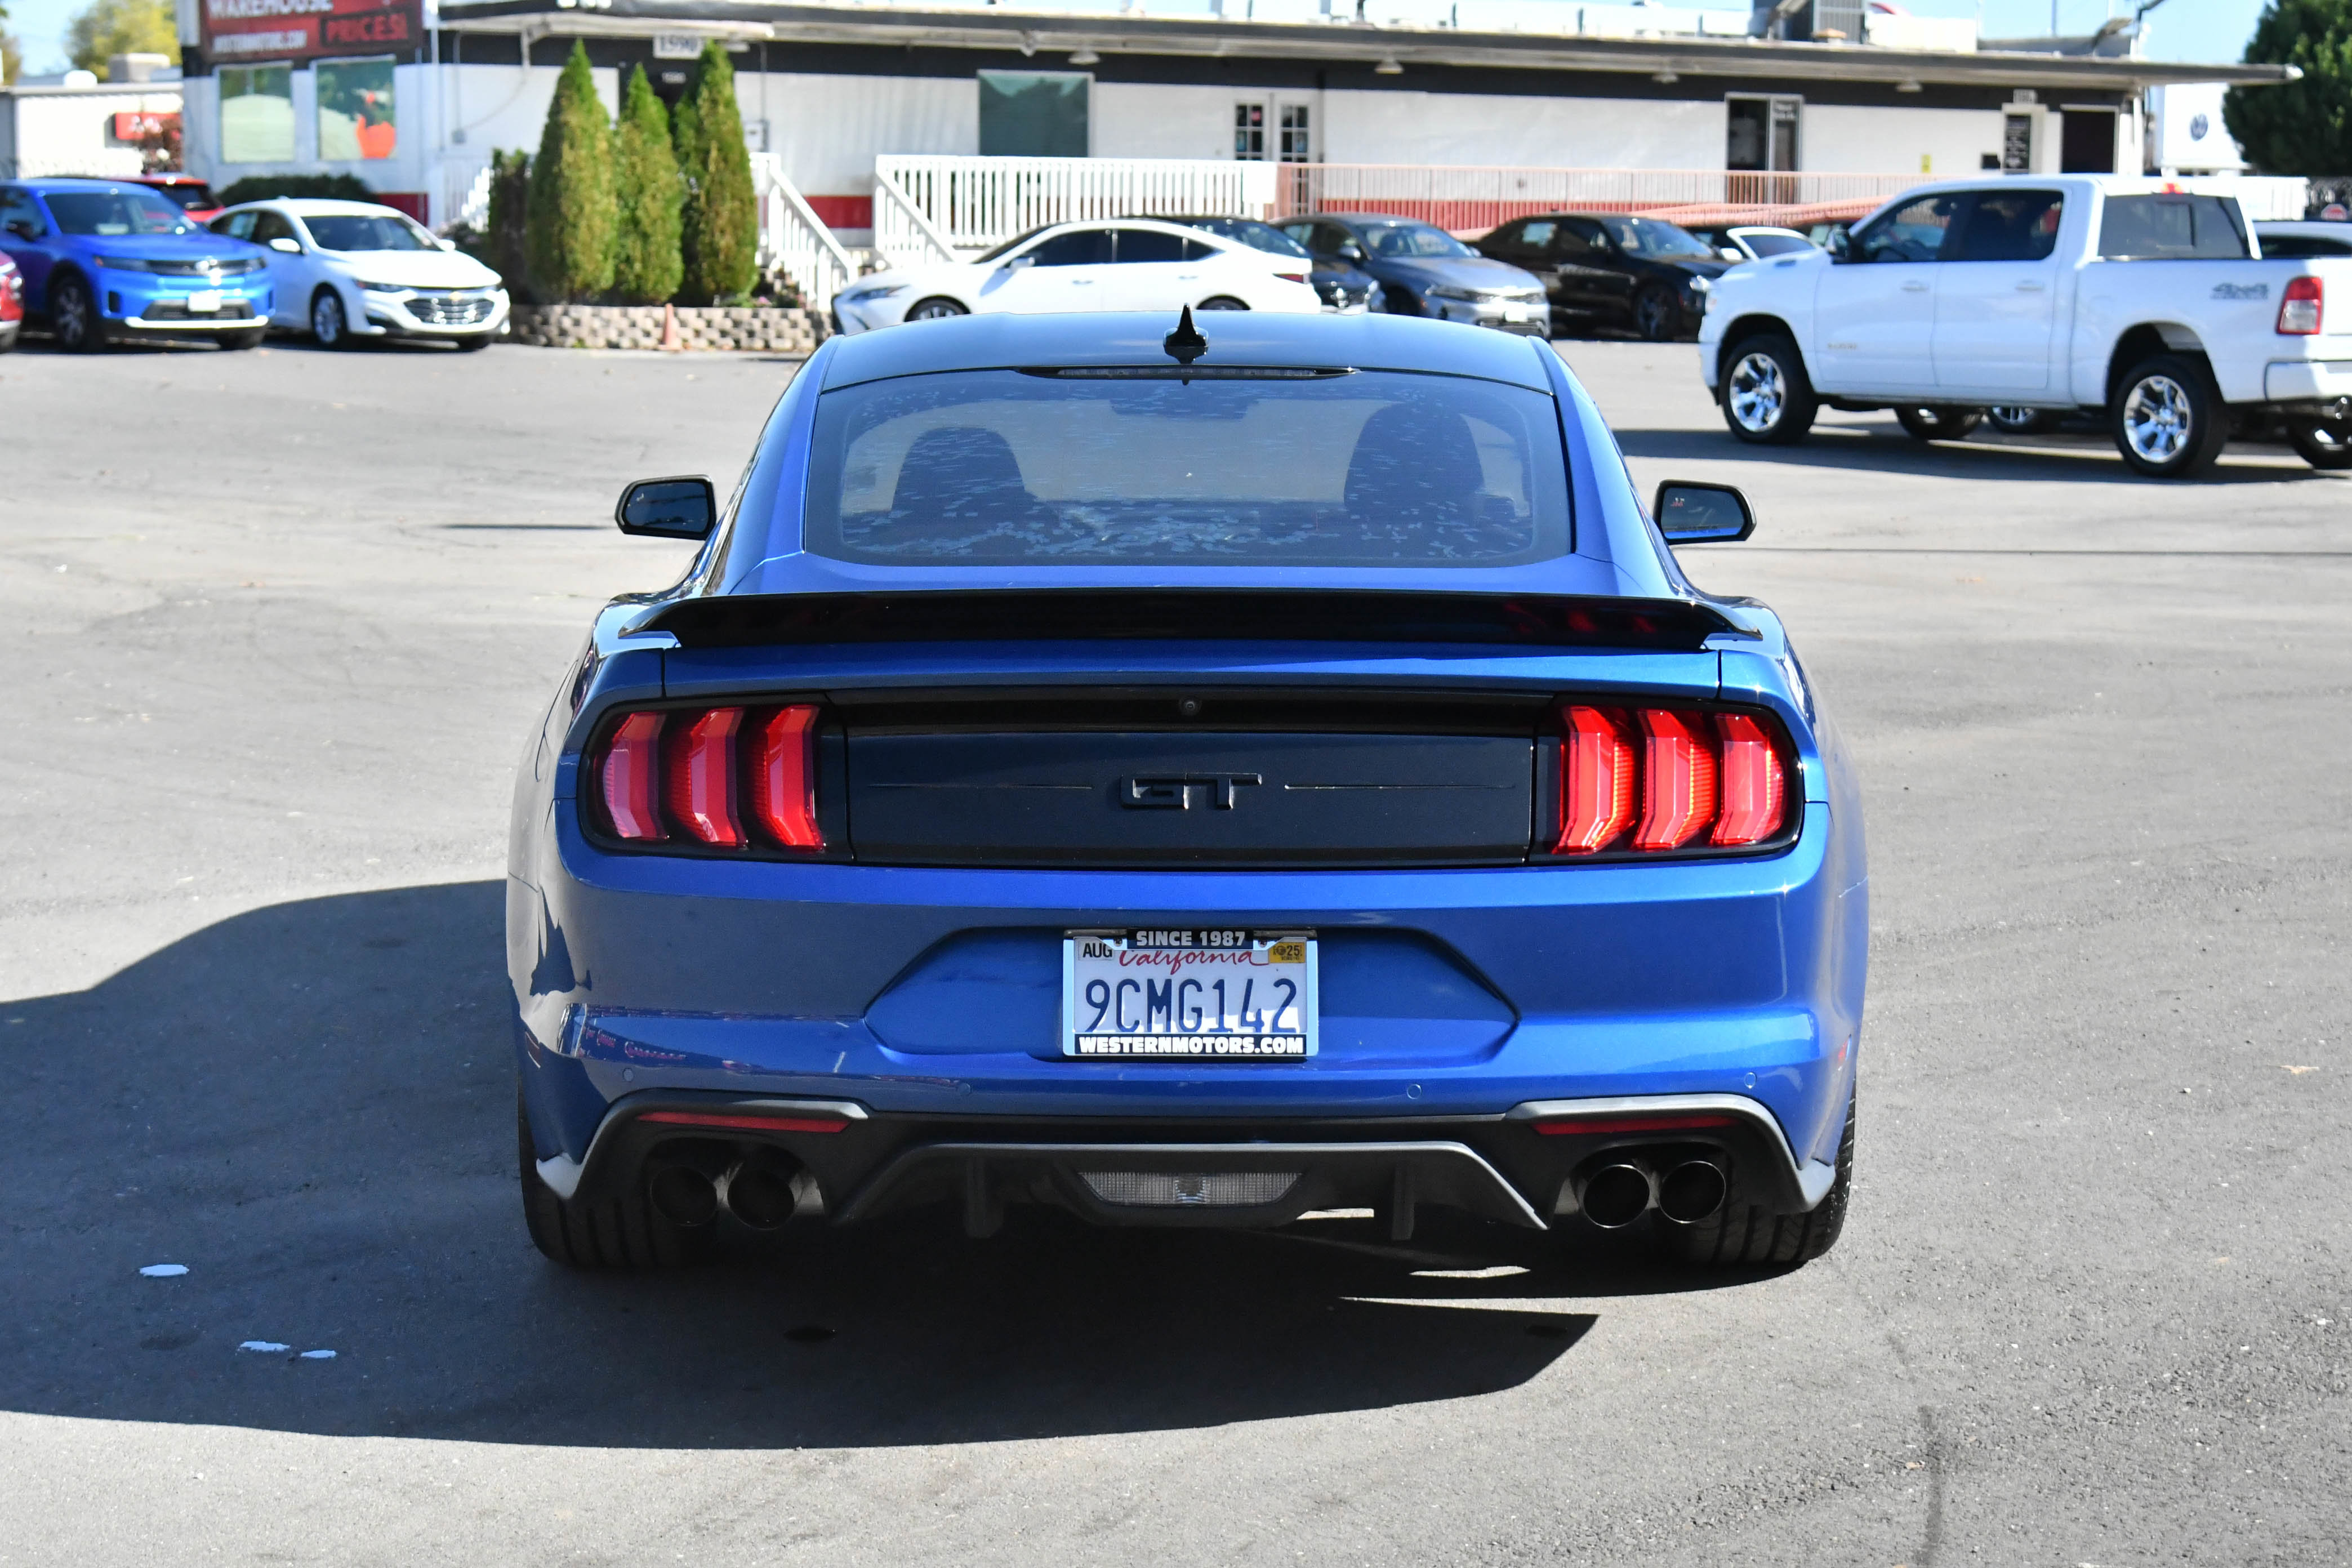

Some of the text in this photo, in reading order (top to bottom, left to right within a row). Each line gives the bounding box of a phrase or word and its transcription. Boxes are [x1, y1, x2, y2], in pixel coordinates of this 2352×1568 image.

[1120, 772, 1262, 810] GT
[1136, 931, 1246, 947] SINCE 1987
[1082, 942, 1113, 958] AUG
[1286, 945, 1300, 956] 25
[1119, 950, 1268, 975] California
[1085, 978, 1297, 1032] 9CMG142
[1079, 1036, 1303, 1054] WESTERNMOTORS.COM
